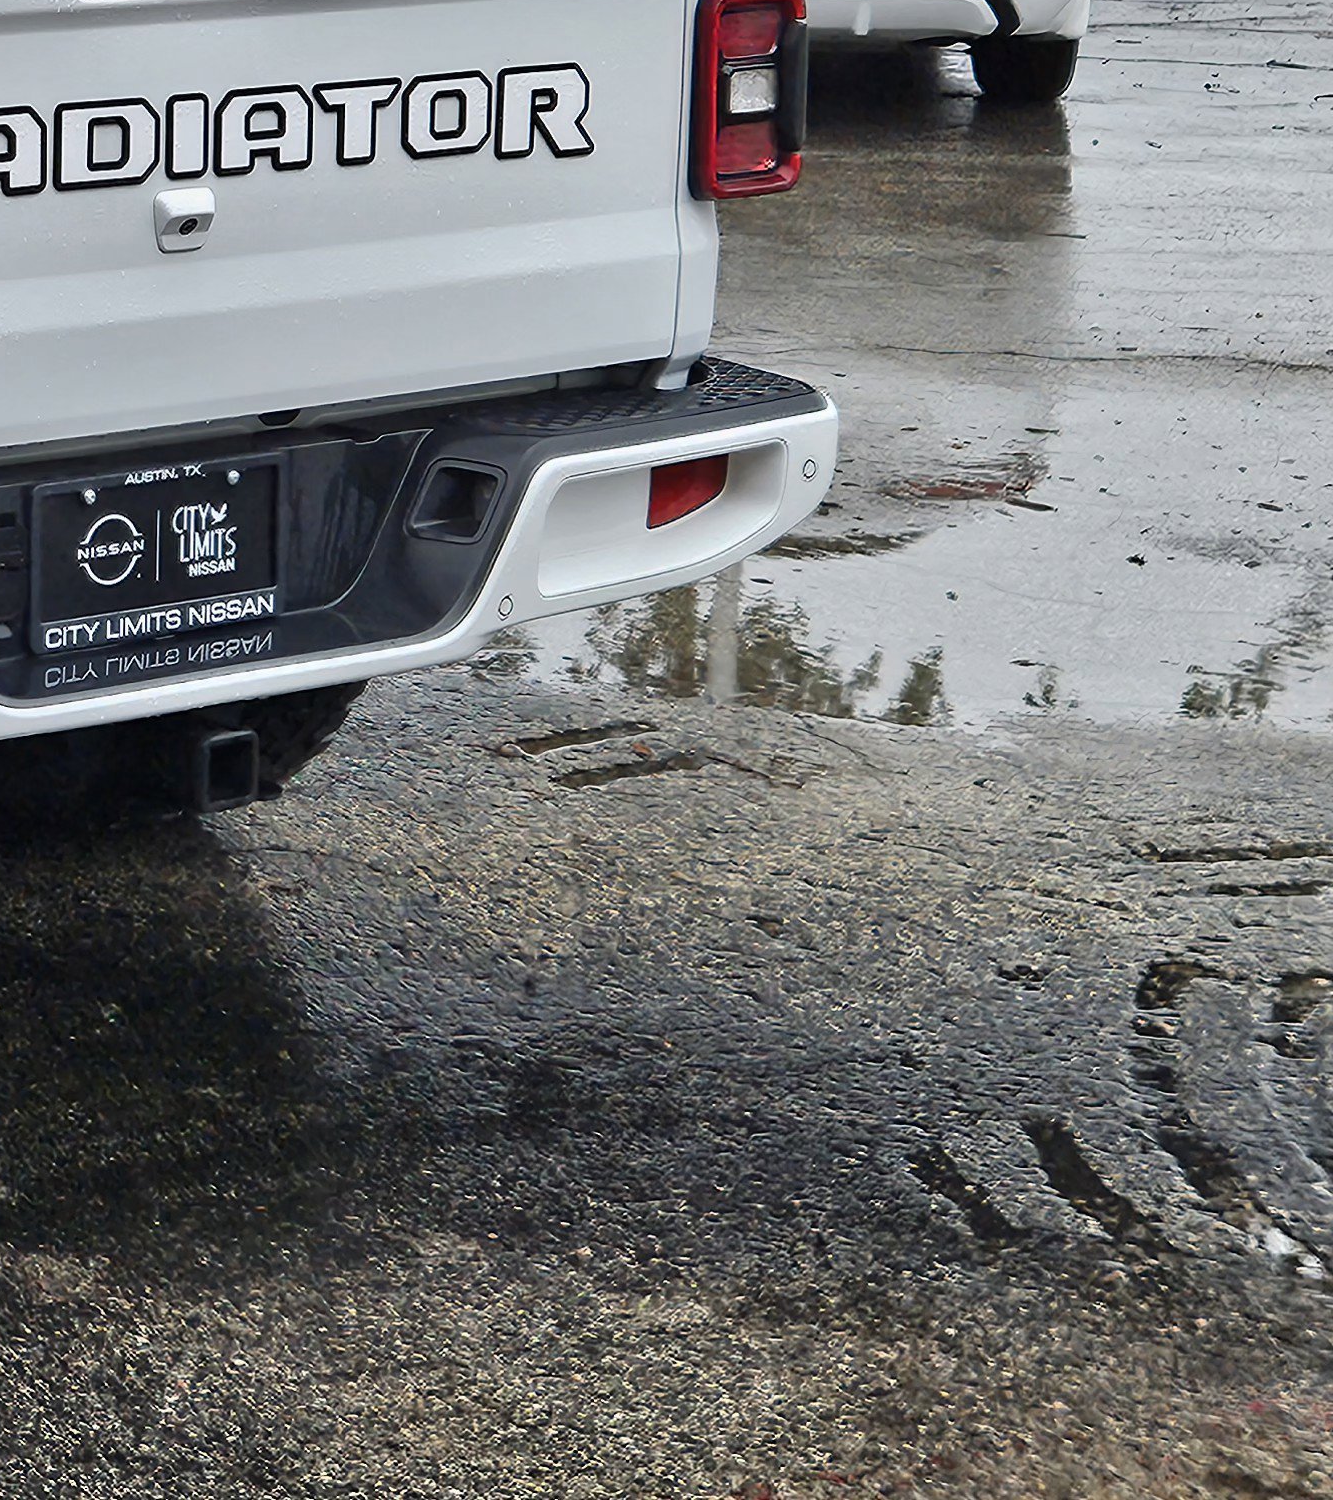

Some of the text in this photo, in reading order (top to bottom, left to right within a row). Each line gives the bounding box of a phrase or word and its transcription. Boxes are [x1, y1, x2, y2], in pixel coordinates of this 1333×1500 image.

[172, 502, 212, 534] CITY
[77, 539, 145, 561] NISSAN
[179, 526, 238, 563] LIMITS
[188, 558, 236, 578] NISSAN
[44, 593, 275, 650] CITY LIMITS NISSAN
